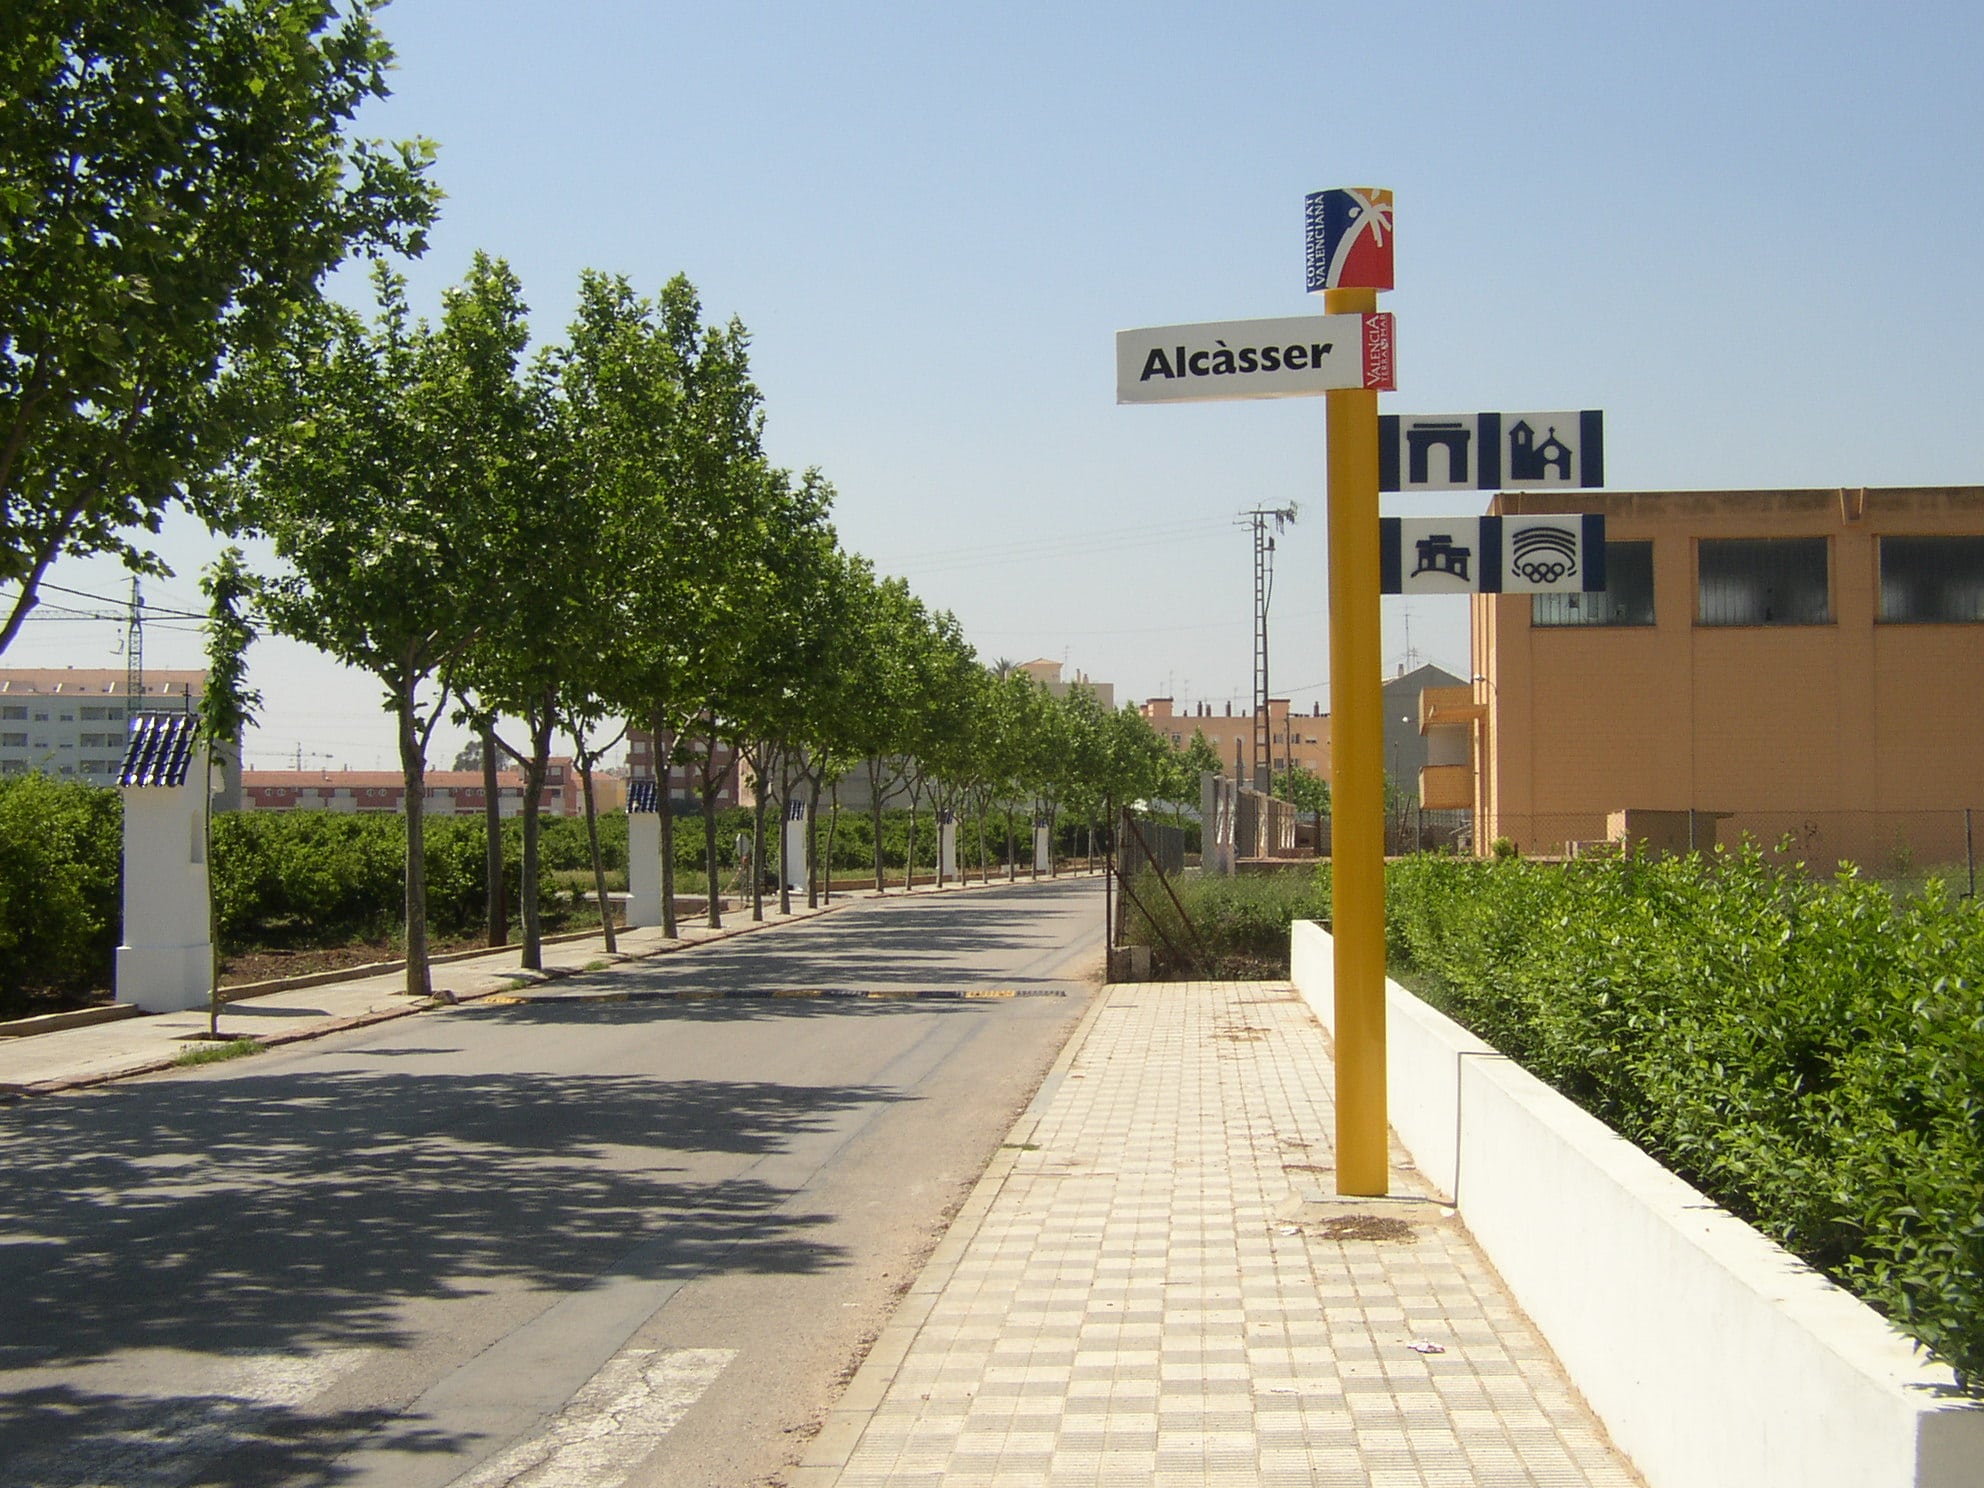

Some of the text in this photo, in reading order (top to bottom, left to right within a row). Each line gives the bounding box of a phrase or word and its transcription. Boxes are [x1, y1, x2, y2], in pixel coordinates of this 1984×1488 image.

[1306, 199, 1315, 287] COMUNITAT
[1315, 195, 1325, 286] VALENCIANA
[1140, 340, 1334, 382] Alcàsser
